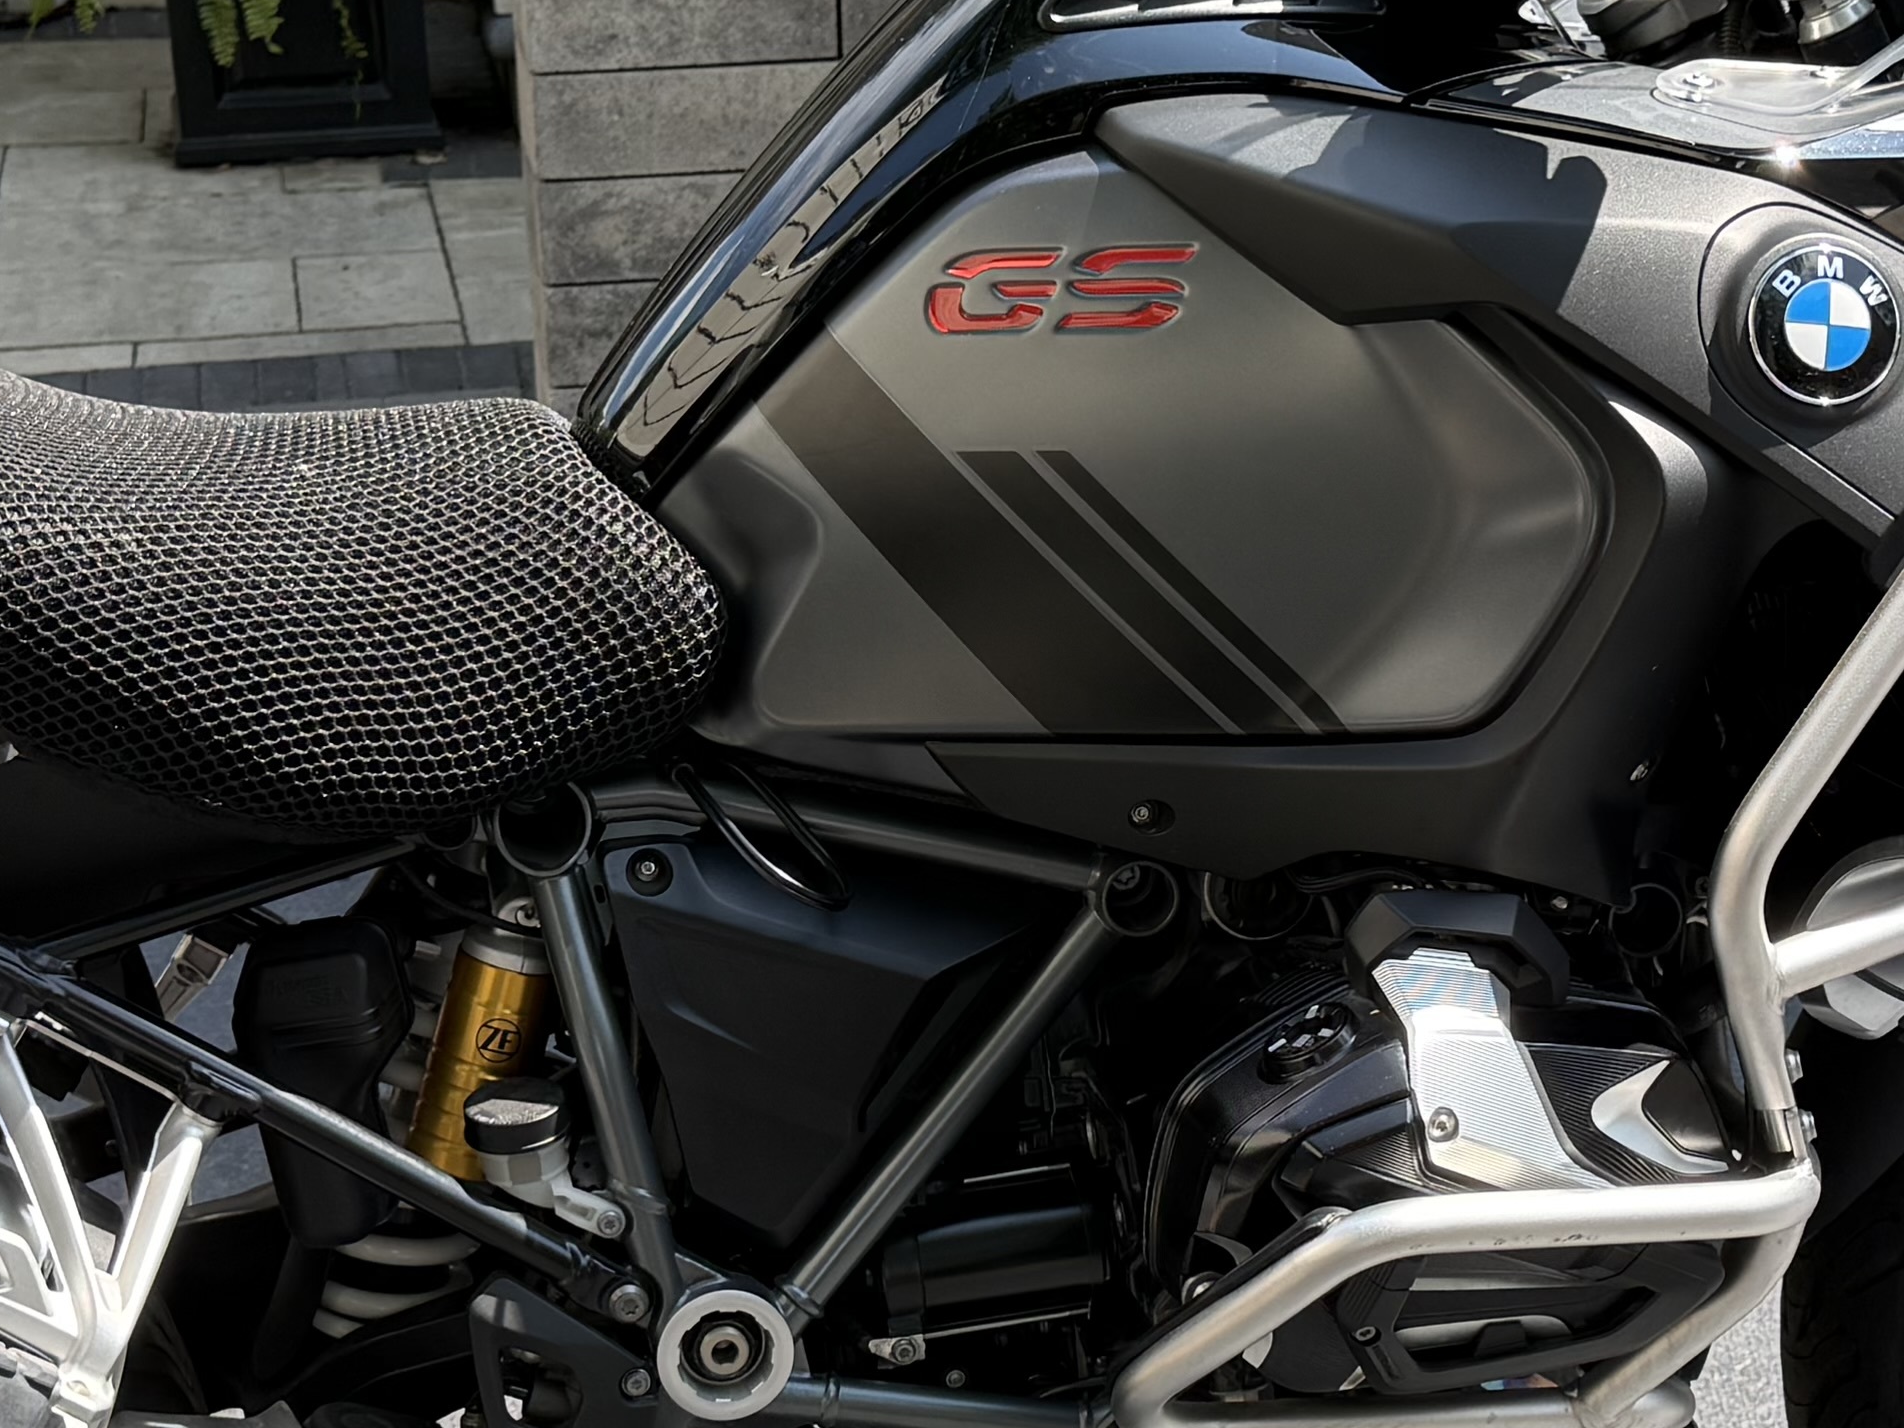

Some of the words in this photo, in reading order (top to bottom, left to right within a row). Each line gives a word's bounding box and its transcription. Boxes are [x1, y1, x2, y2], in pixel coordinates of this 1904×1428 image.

[925, 243, 1198, 337] GS
[1772, 255, 1889, 307] BMW
[479, 1023, 521, 1057] ZF
